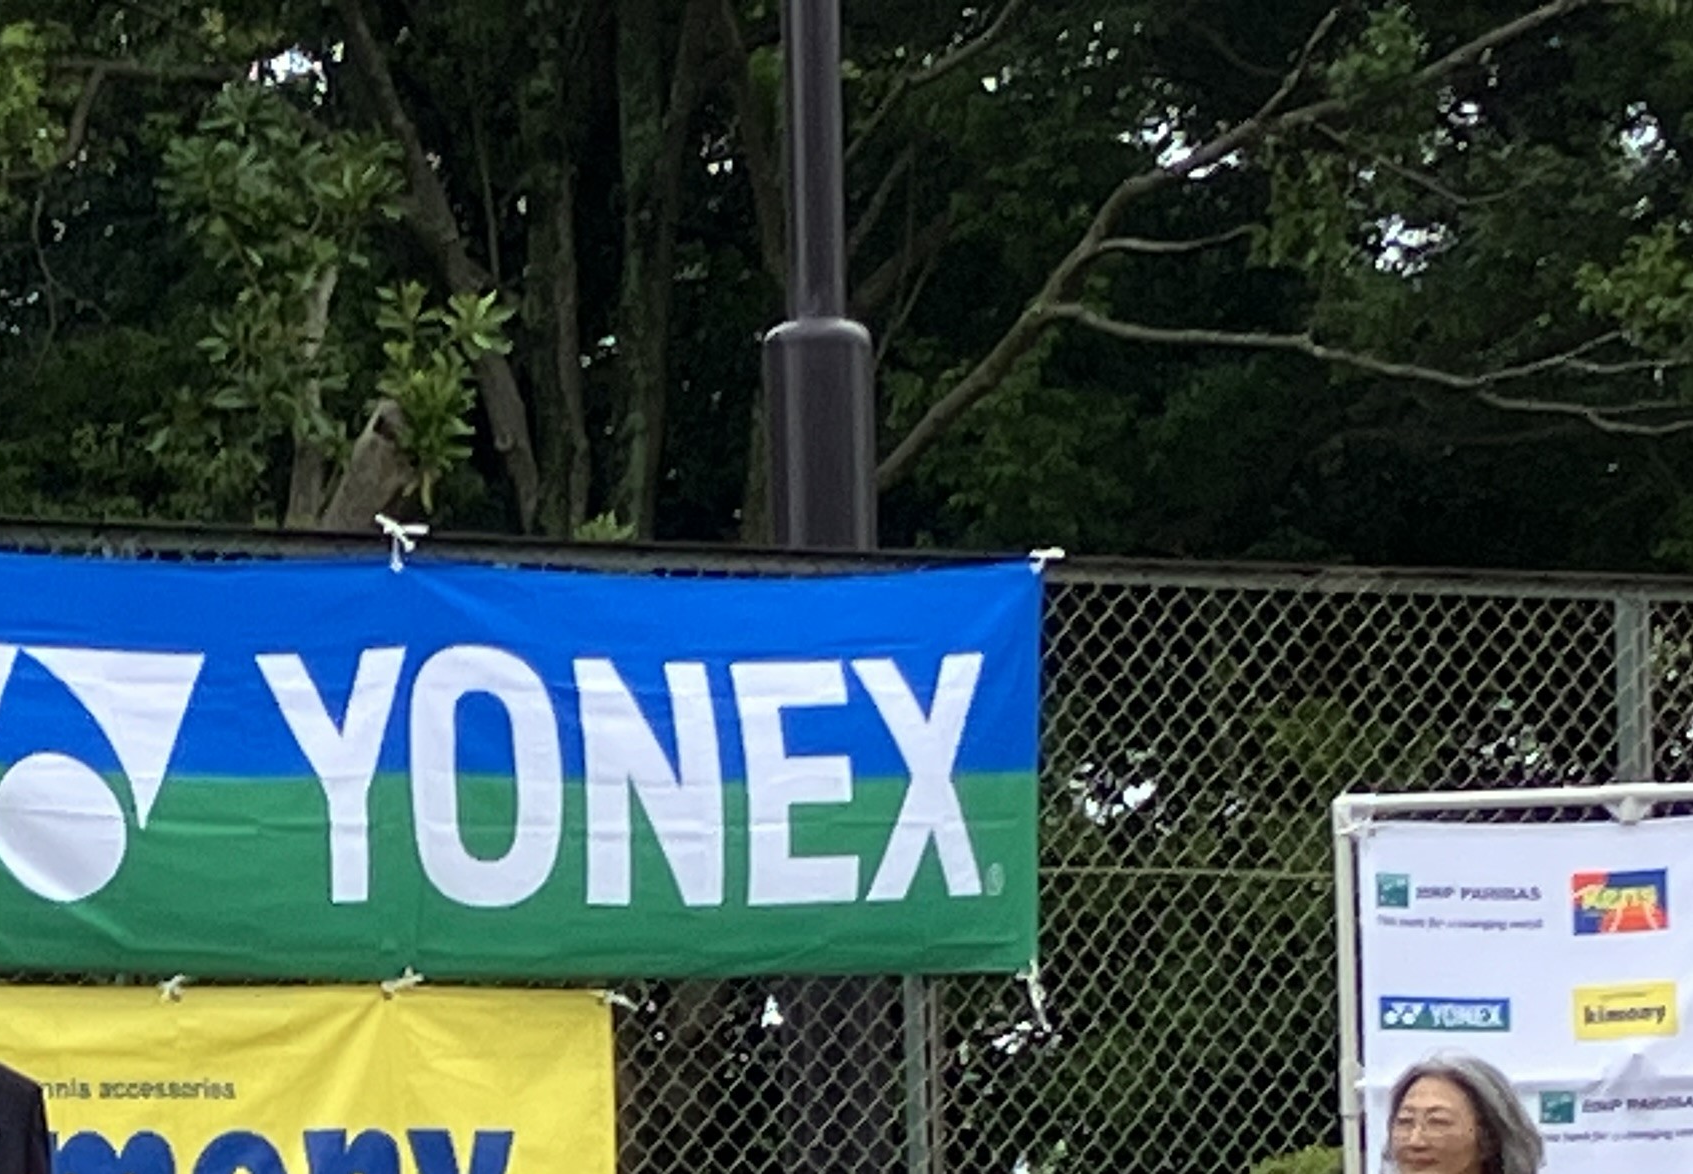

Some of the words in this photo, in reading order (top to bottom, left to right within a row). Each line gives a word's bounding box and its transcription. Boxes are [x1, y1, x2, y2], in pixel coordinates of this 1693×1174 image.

[255, 642, 984, 907] YONEX
[42, 1077, 91, 1100] nnis
[99, 1077, 236, 1100] accessories
